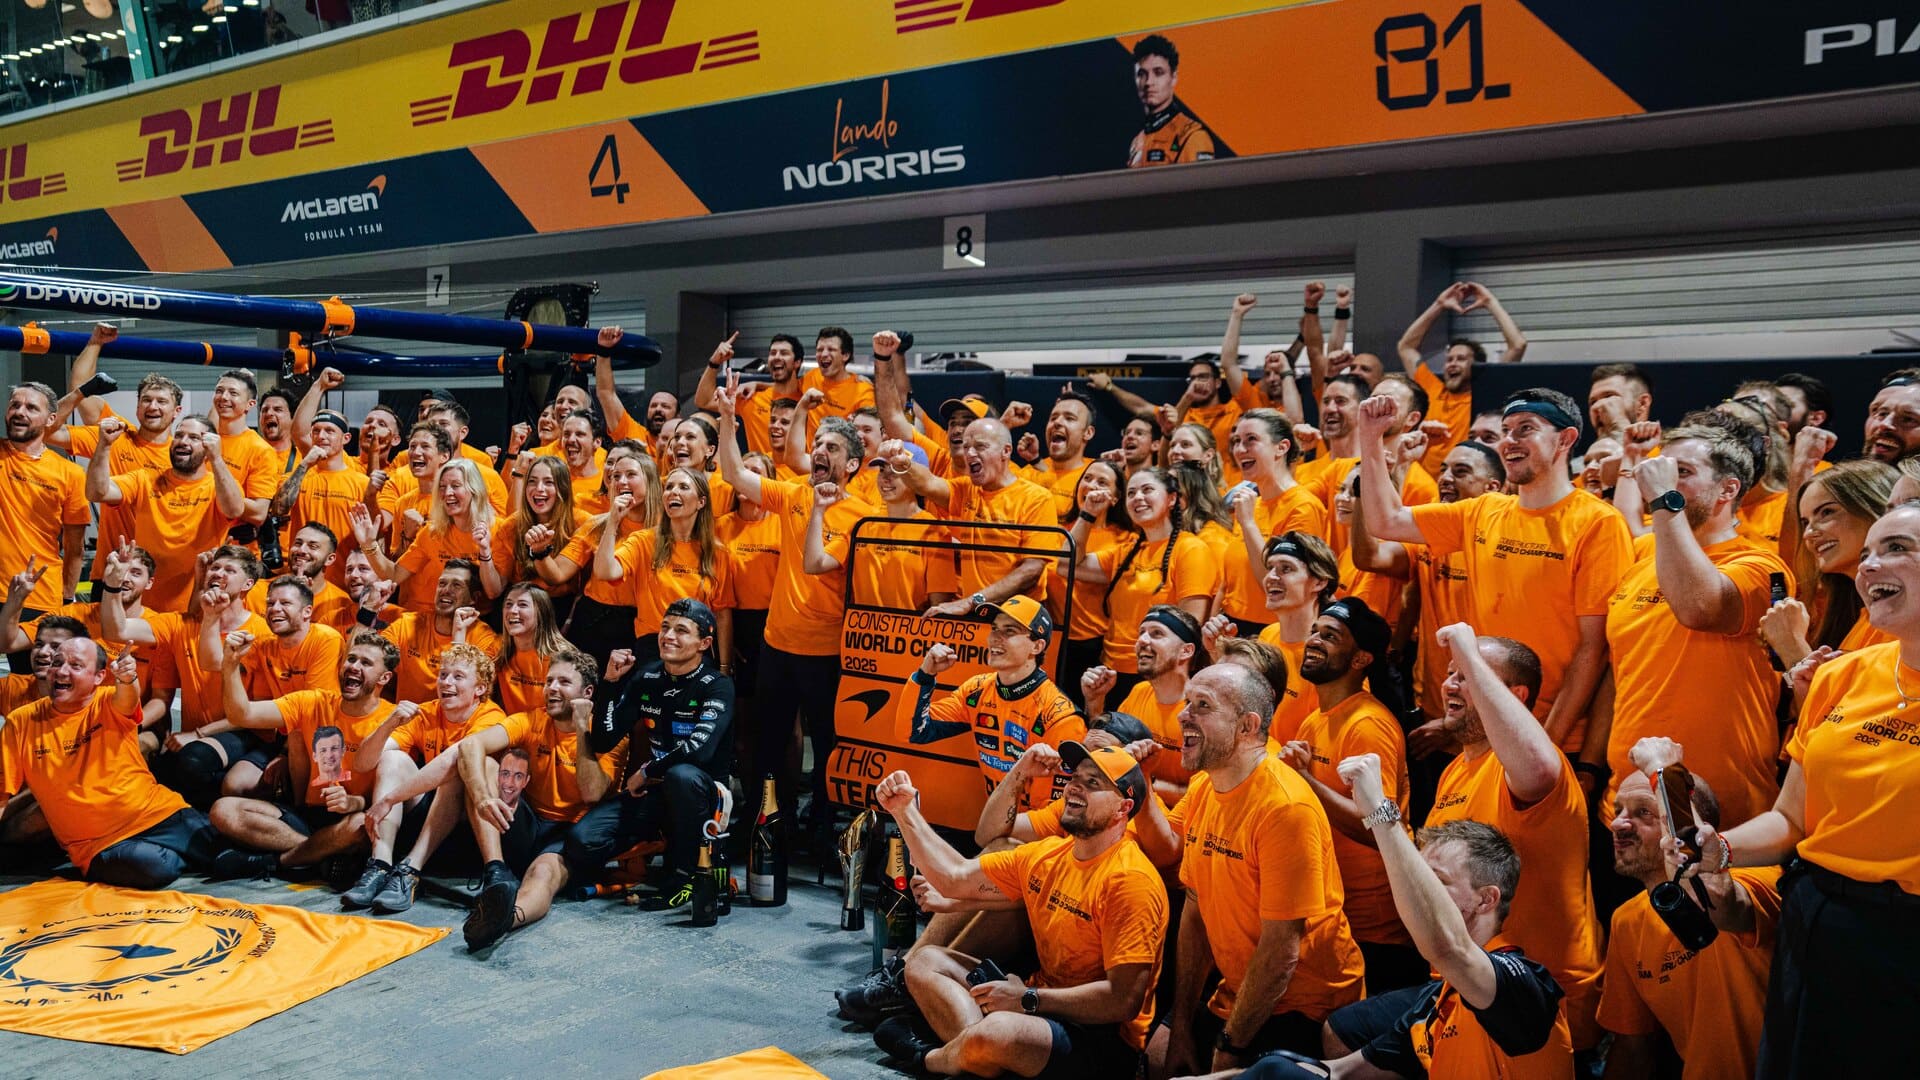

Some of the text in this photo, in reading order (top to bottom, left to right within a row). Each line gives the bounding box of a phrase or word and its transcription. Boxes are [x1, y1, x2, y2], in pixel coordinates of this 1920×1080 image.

[448, 0, 703, 120] DHL
[1374, 4, 1511, 111] 81
[139, 84, 299, 178] DHL
[832, 79, 898, 163] Lando
[0, 143, 42, 205] L
[588, 134, 630, 204] 4
[782, 144, 966, 191] NORRIS
[280, 192, 379, 223] McLaren
[304, 223, 383, 242] FORMULA 1 TEAM
[955, 225, 973, 257] 8
[25, 282, 162, 310] DP WORLD
[433, 274, 443, 298] 7
[1077, 367, 1142, 378] DWALT
[847, 611, 980, 641] CONSTRUCTORS'
[844, 630, 990, 666] WORLD CHMPI
[844, 655, 878, 673] 2025
[641, 704, 661, 715] Android
[1854, 732, 1881, 747] 2025
[1862, 720, 1909, 742] WORLD
[836, 745, 887, 779] THIS
[830, 776, 888, 812] TEA
